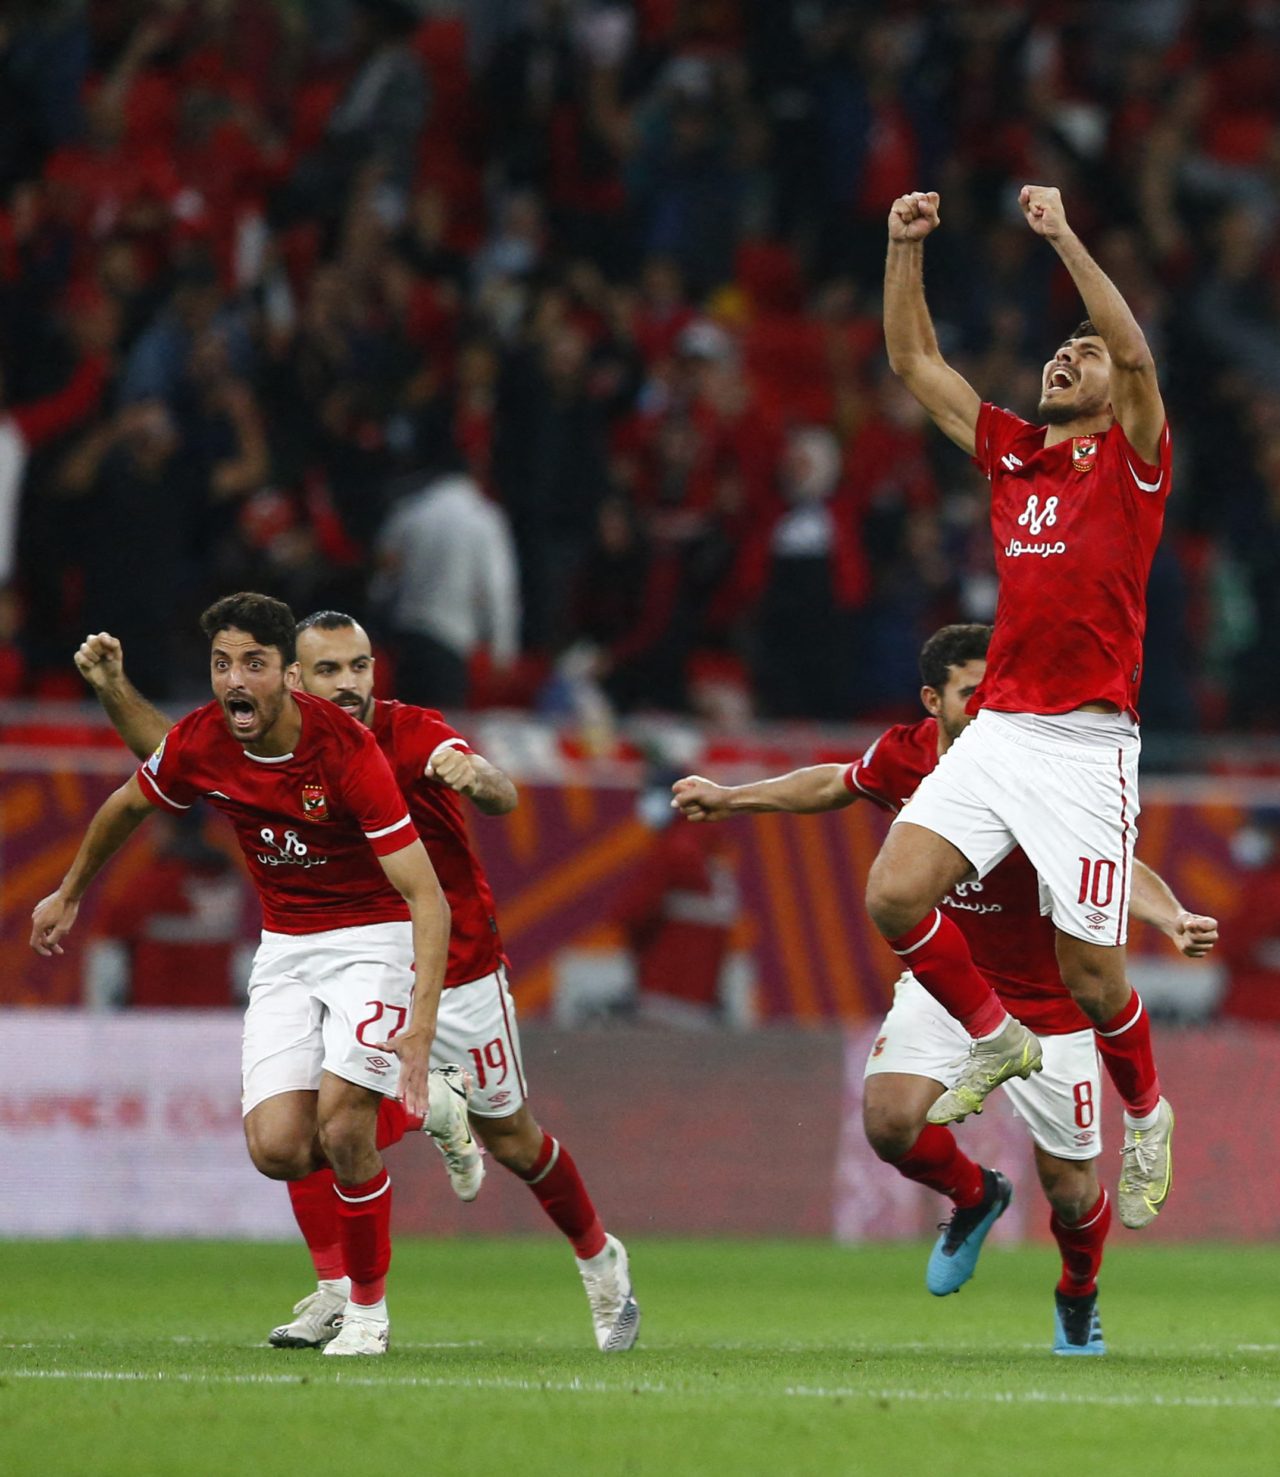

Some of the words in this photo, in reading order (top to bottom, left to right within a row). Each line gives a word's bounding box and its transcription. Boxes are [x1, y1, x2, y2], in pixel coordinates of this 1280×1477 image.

[1005, 538, 1065, 558] مرسول
[1077, 856, 1116, 907] 10
[355, 1000, 408, 1054] 27
[467, 1037, 508, 1089] 19
[1072, 1080, 1094, 1129] 8
